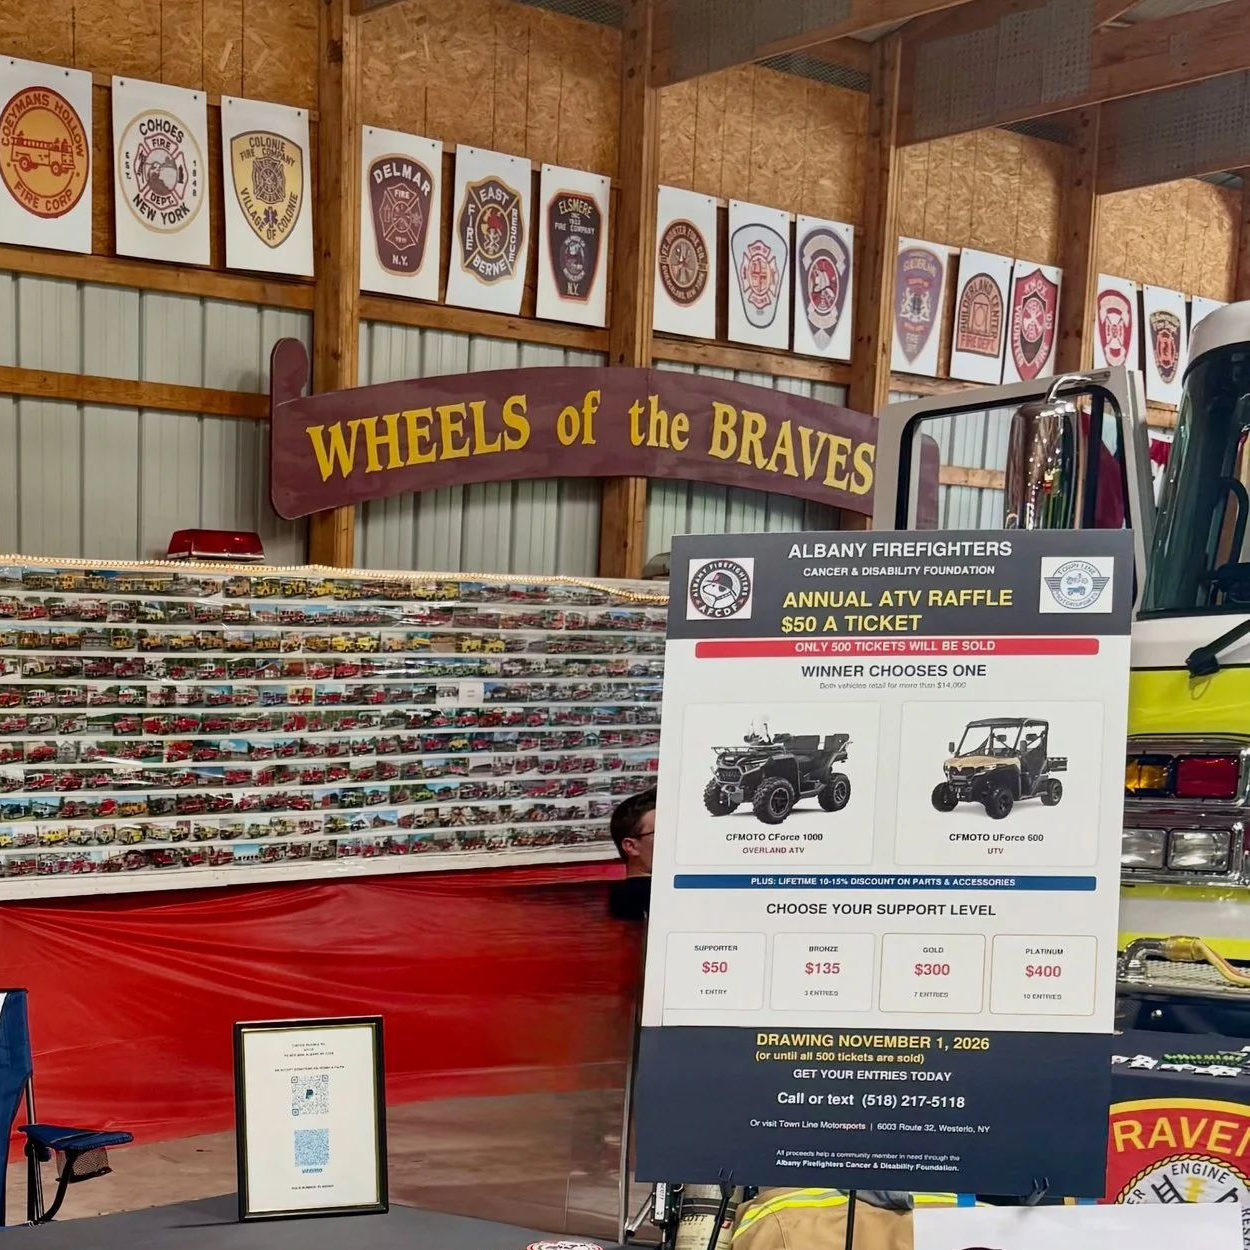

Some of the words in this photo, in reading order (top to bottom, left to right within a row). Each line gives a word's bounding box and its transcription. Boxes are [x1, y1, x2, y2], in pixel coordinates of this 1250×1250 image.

[1, 94, 51, 146] COEYMANS
[54, 100, 84, 158] HOLLOW
[139, 119, 184, 144] COHOES
[152, 138, 171, 149] FIRE
[249, 137, 286, 150] COLONIE
[373, 162, 431, 197] DELMAR
[14, 181, 39, 209] FIRE
[45, 189, 73, 211] CORP
[480, 186, 509, 205] EAST
[133, 195, 156, 224] NEW
[161, 203, 190, 225] YORK
[559, 199, 593, 218] ELSMERE
[466, 204, 476, 250] FIRE
[509, 208, 518, 262] RESCUE
[473, 255, 507, 276] BERNE
[305, 395, 531, 482] WHEELS
[557, 390, 601, 446] of
[629, 395, 690, 450] the
[708, 401, 876, 496] BRAVES
[788, 543, 867, 558] ALBANY
[873, 541, 1012, 557] FIREFIGHTERS
[783, 591, 872, 608] ANNUAL
[879, 590, 922, 606] ATV
[929, 590, 1013, 606] RAFFLE
[782, 616, 816, 633] $50
[823, 616, 837, 631] A
[844, 615, 922, 631] TICKET
[801, 665, 864, 677] WINNER
[869, 665, 947, 677] CHOOSES
[953, 665, 986, 676] ONE
[726, 833, 766, 841] CFMOTO
[768, 833, 800, 841] CForce
[702, 961, 727, 974] $50
[805, 962, 840, 975] $135
[914, 963, 950, 976] $300
[1025, 965, 1061, 978] $400
[757, 1034, 833, 1047] DRAWING
[839, 1035, 931, 1048] NOVEMBER
[935, 1037, 949, 1051] 1,
[953, 1037, 989, 1049] 2026
[862, 1094, 897, 1109] (518)
[901, 1095, 965, 1108] 217-5118
[820, 1121, 866, 1130] Motorsports
[1171, 1162, 1230, 1185] ENGINE
